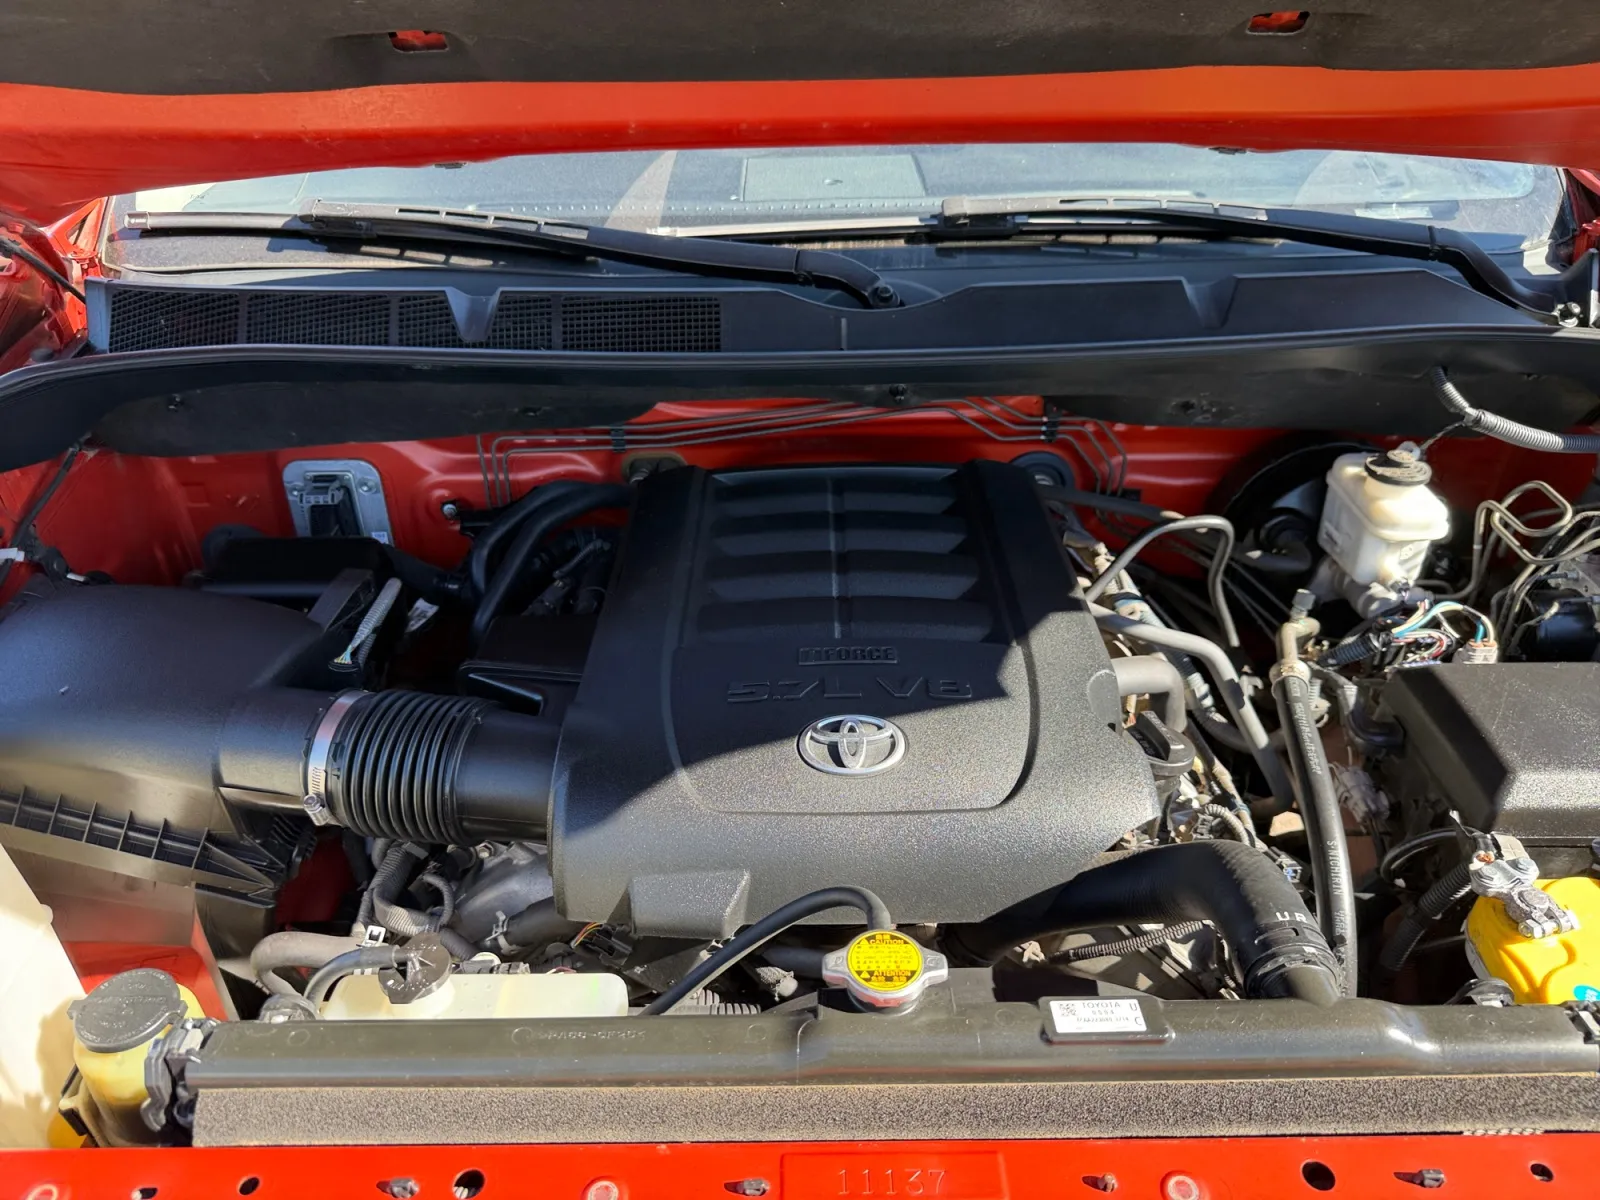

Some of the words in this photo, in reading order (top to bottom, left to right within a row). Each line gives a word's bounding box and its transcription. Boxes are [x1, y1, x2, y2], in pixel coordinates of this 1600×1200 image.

[876, 675, 973, 699] V8
[1082, 1001, 1121, 1009] TOYOTA
[1134, 1016, 1143, 1026] C
[836, 1168, 946, 1196] 11137
